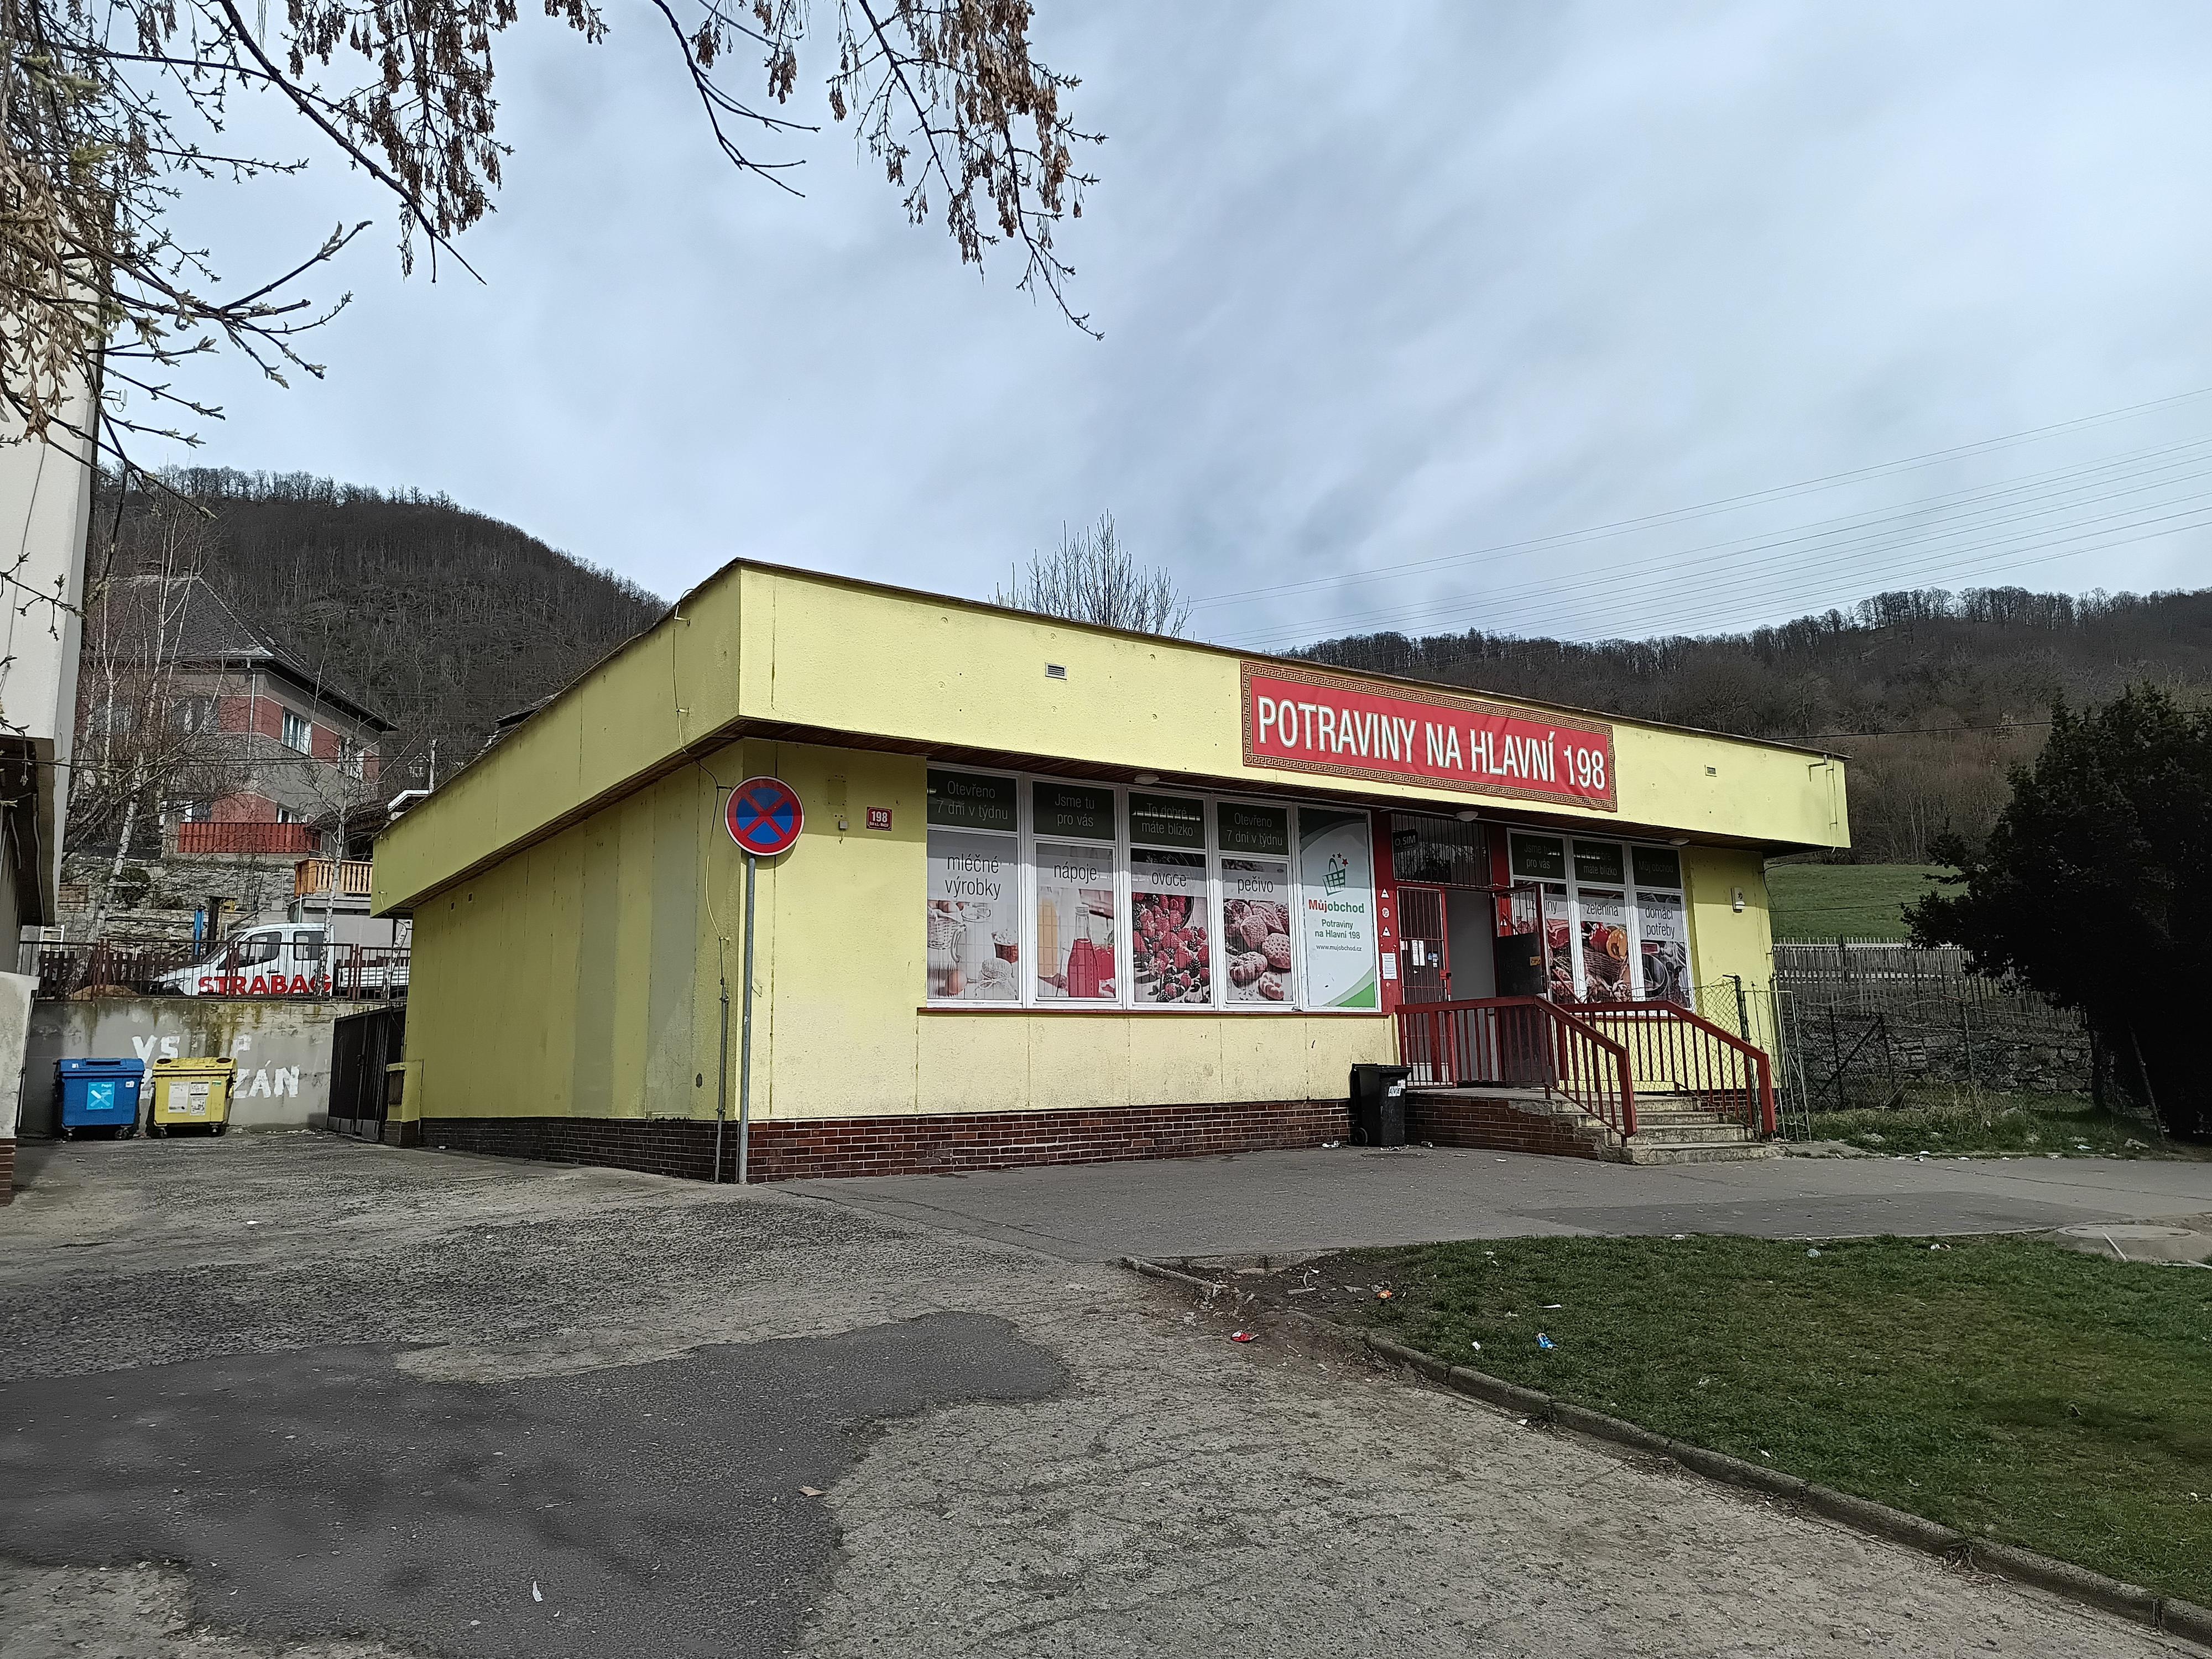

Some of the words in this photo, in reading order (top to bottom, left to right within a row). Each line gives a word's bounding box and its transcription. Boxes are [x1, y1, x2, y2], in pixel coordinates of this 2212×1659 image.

[1258, 695, 1416, 764] POTRAVINY
[1425, 721, 1463, 770] NA
[1469, 727, 1556, 783] HLAVNÍ
[1563, 744, 1605, 791] 198
[947, 780, 996, 799] Otevřeno
[1055, 793, 1082, 808] Jsme
[1085, 796, 1095, 810] tu
[871, 811, 888, 823] 198
[937, 799, 943, 813] 7
[948, 801, 965, 816] dní
[968, 806, 974, 816] v
[978, 804, 1008, 821] týdnu
[1146, 802, 1158, 815] To
[1161, 805, 1187, 818] dobré
[1057, 813, 1073, 827] pro
[1077, 813, 1094, 827] vás
[1234, 812, 1272, 828] Otevřeno
[1141, 820, 1165, 834] máte
[1167, 822, 1193, 837] blízko
[1226, 830, 1232, 842] 7
[1235, 831, 1249, 844] dní
[1251, 834, 1256, 843] v
[1259, 833, 1283, 848] týdnu
[1524, 842, 1542, 854] Jsme
[947, 852, 999, 874] mléčné
[1526, 858, 1537, 869] pro
[1539, 858, 1551, 869] vás
[1583, 863, 1598, 875] máte
[1600, 864, 1618, 877] blízko
[1053, 860, 1097, 884] nápoje
[1151, 872, 1187, 888] ovoce
[945, 875, 1001, 900] výrobky
[1237, 875, 1274, 894] pečivo
[1308, 899, 1365, 914] Můjobchod
[1586, 901, 1619, 917] zelenina
[1645, 905, 1673, 920] domácí
[1321, 919, 1353, 930] Potraviny
[1646, 922, 1675, 940] potřeby
[1326, 930, 1347, 939] Hlavní
[198, 974, 332, 995] STRABAG
